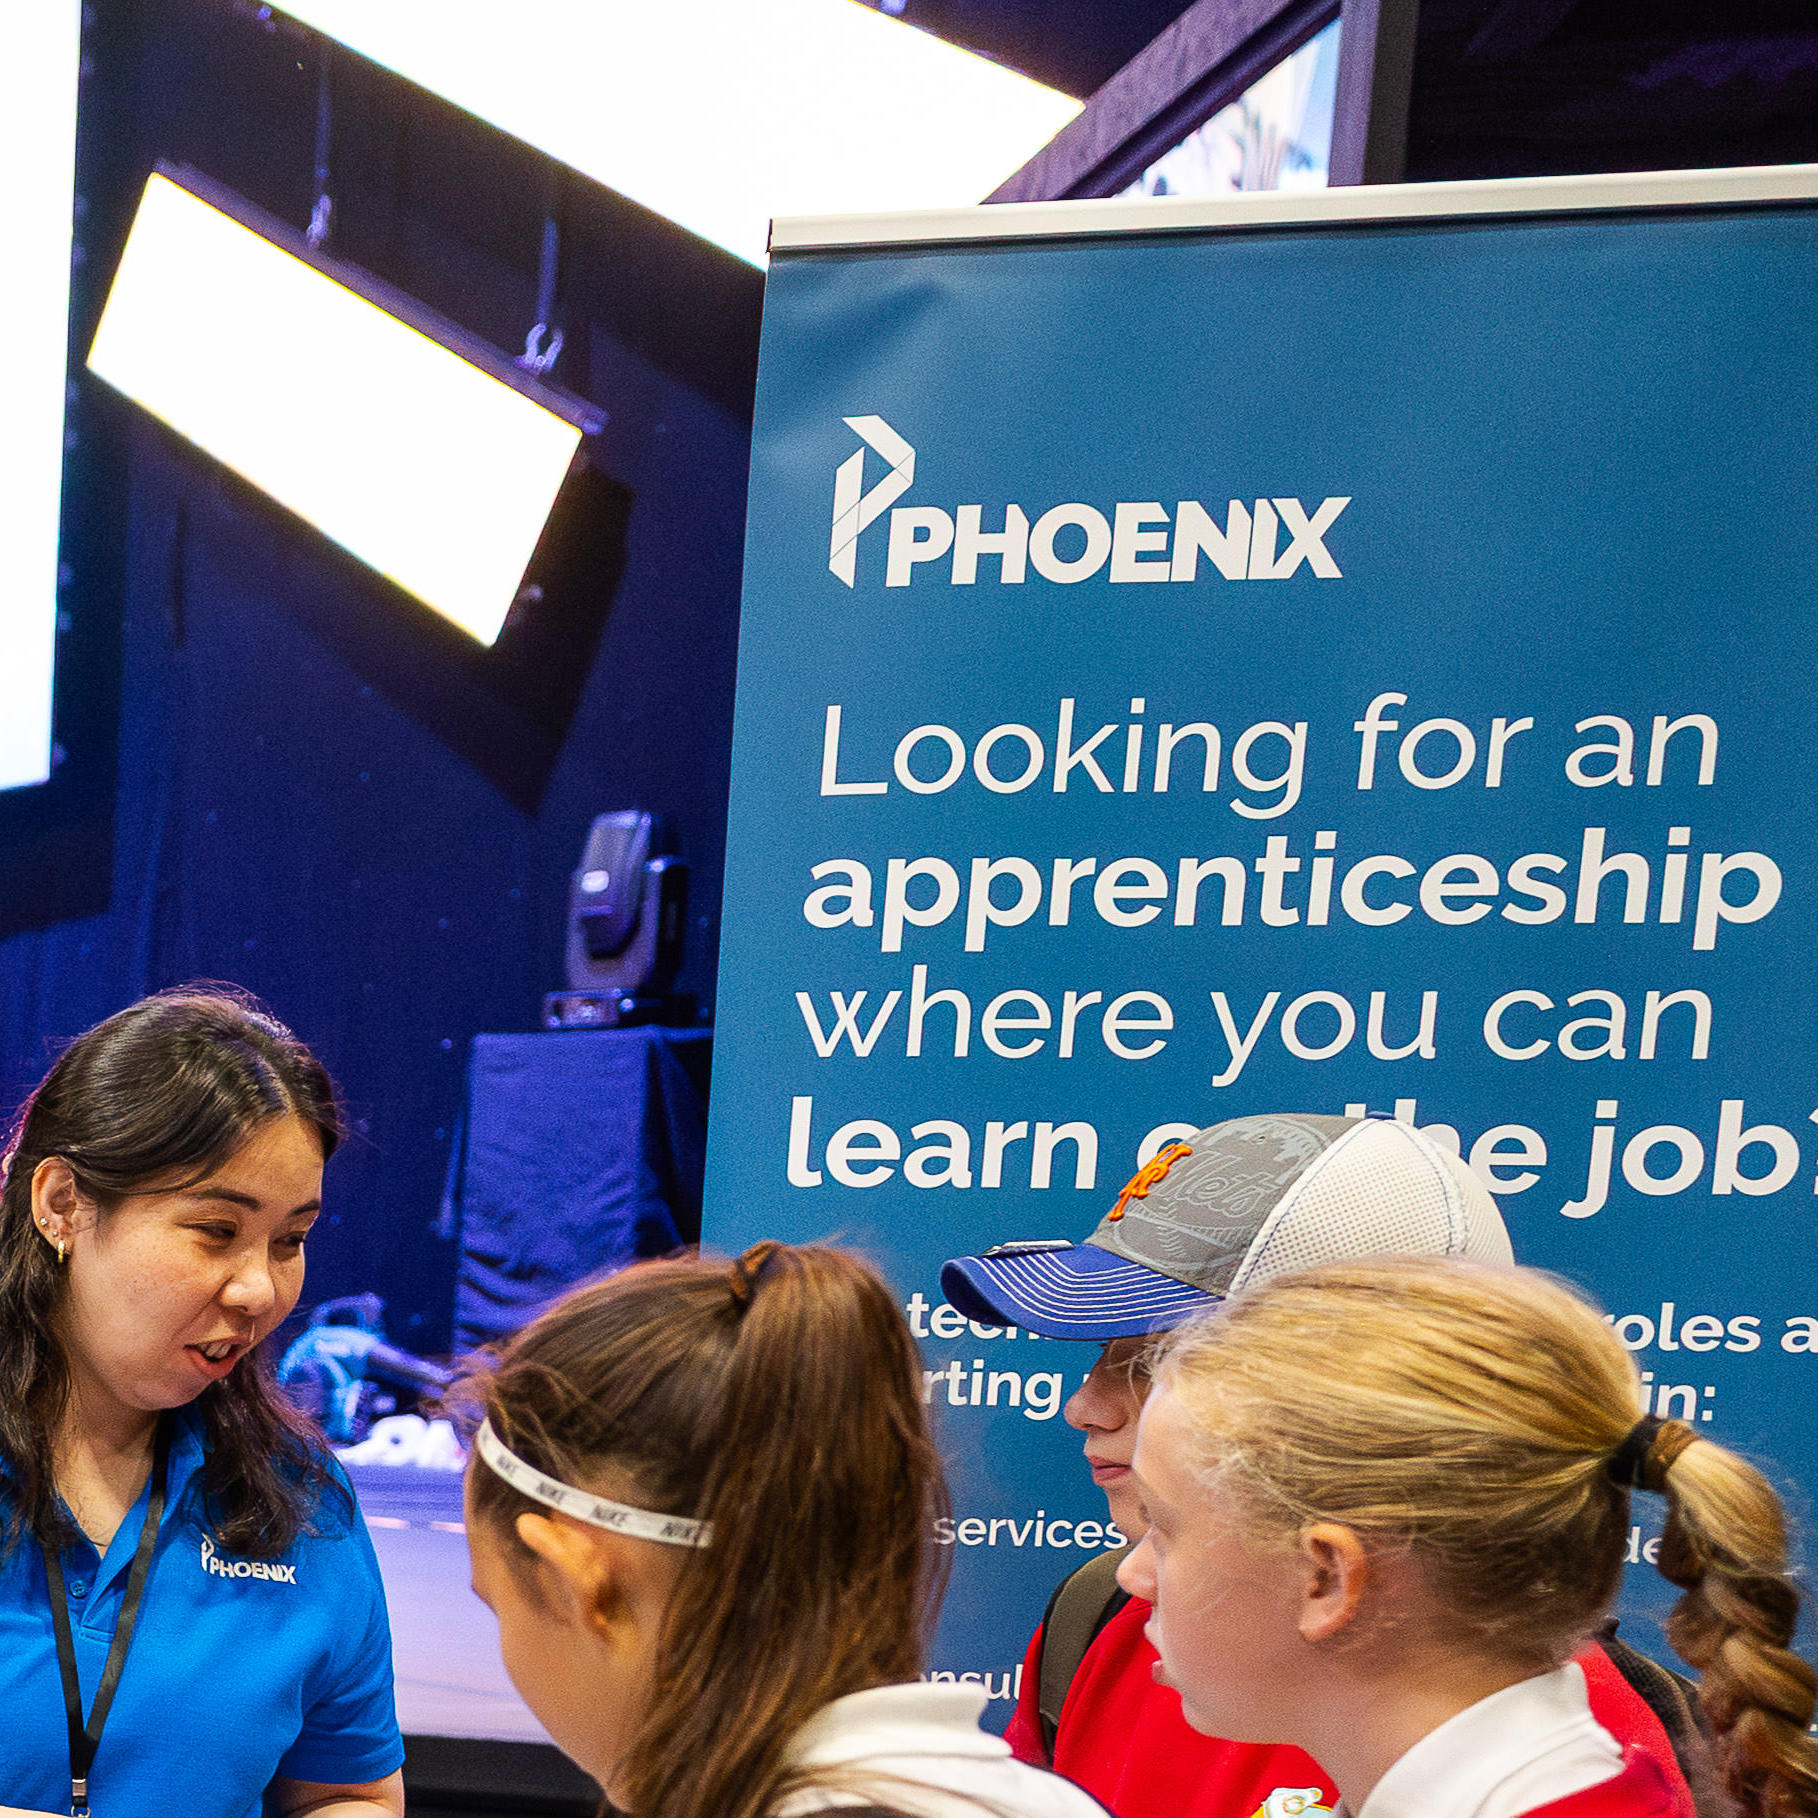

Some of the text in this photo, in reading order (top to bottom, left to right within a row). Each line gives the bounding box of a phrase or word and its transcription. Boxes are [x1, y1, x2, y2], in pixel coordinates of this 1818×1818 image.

[884, 496, 1353, 588] PHOENIX
[820, 691, 1719, 820] Looking for an
[803, 826, 1783, 953] apprenticeship
[795, 965, 1712, 1088] where you can
[787, 1095, 1098, 1190] learn
[922, 1358, 1063, 1421] rting
[209, 1556, 297, 1585] PHOENIX
[932, 1509, 1129, 1550] services
